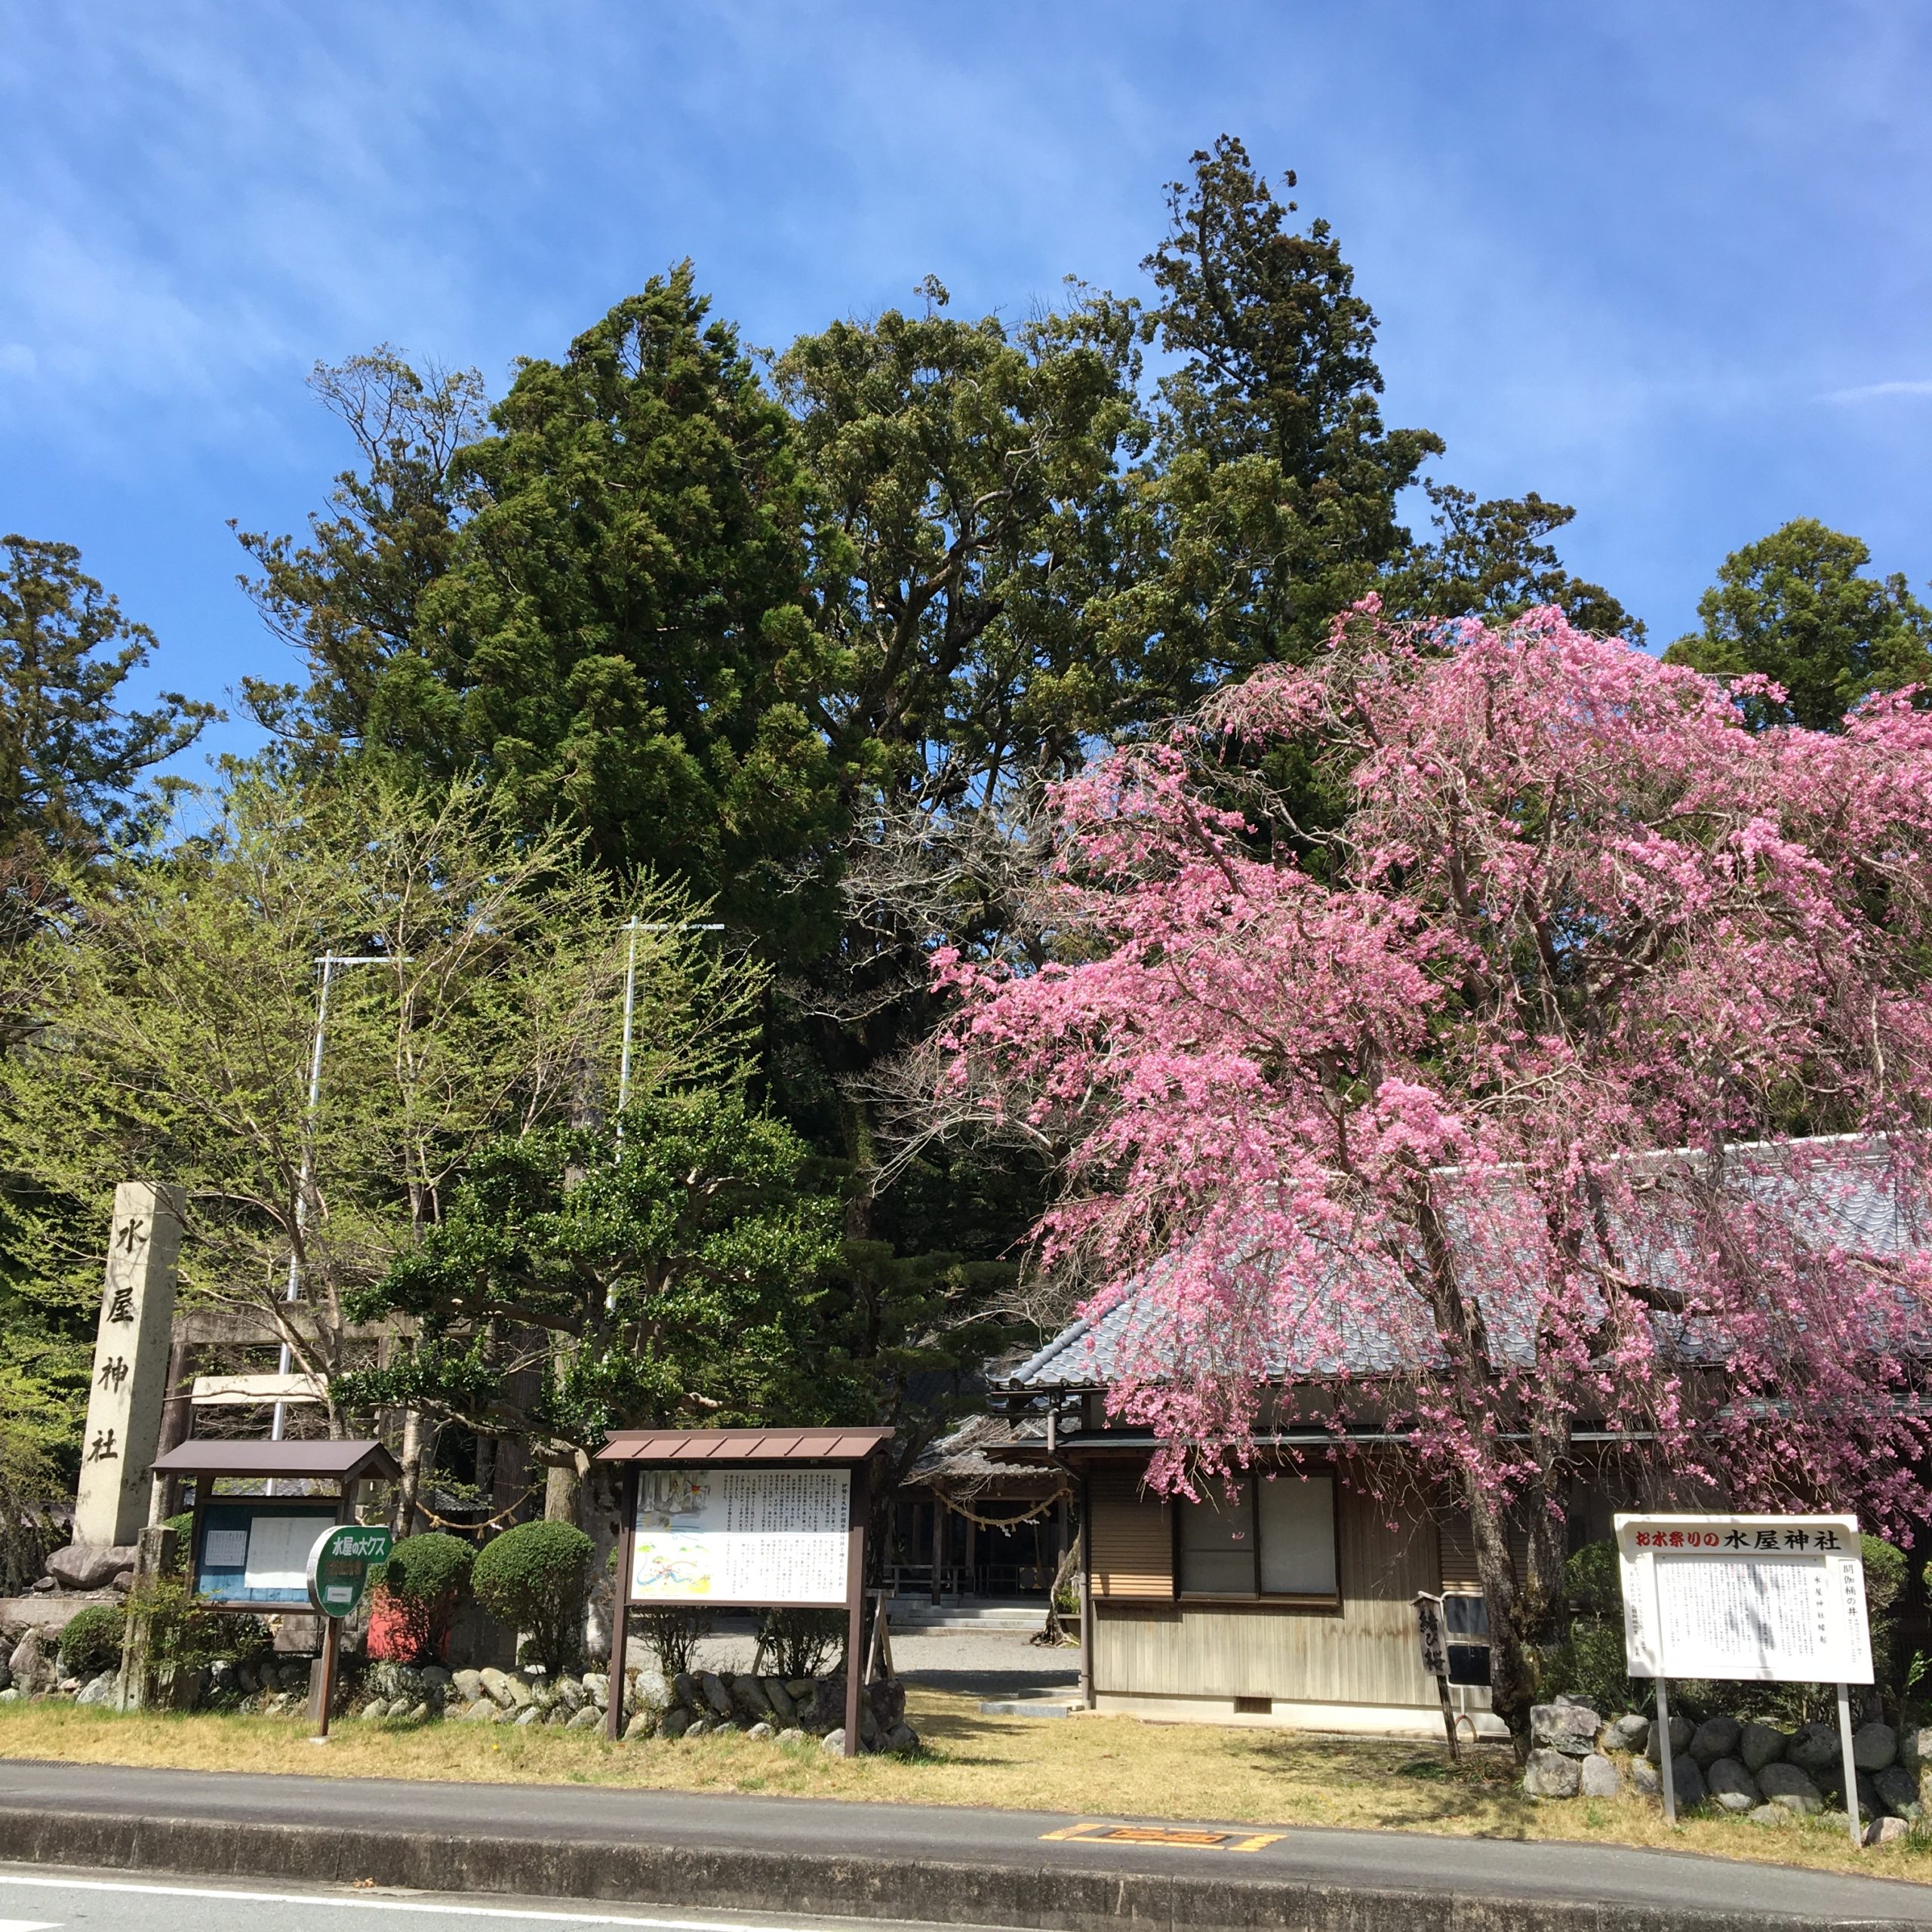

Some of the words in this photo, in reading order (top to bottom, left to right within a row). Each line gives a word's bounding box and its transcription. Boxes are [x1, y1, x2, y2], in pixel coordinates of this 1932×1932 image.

[88, 1218, 147, 1462] 水屋神社
[332, 1537, 386, 1556] 水屋の大クス
[1814, 1576, 1827, 1644] 水屋神社縁起
